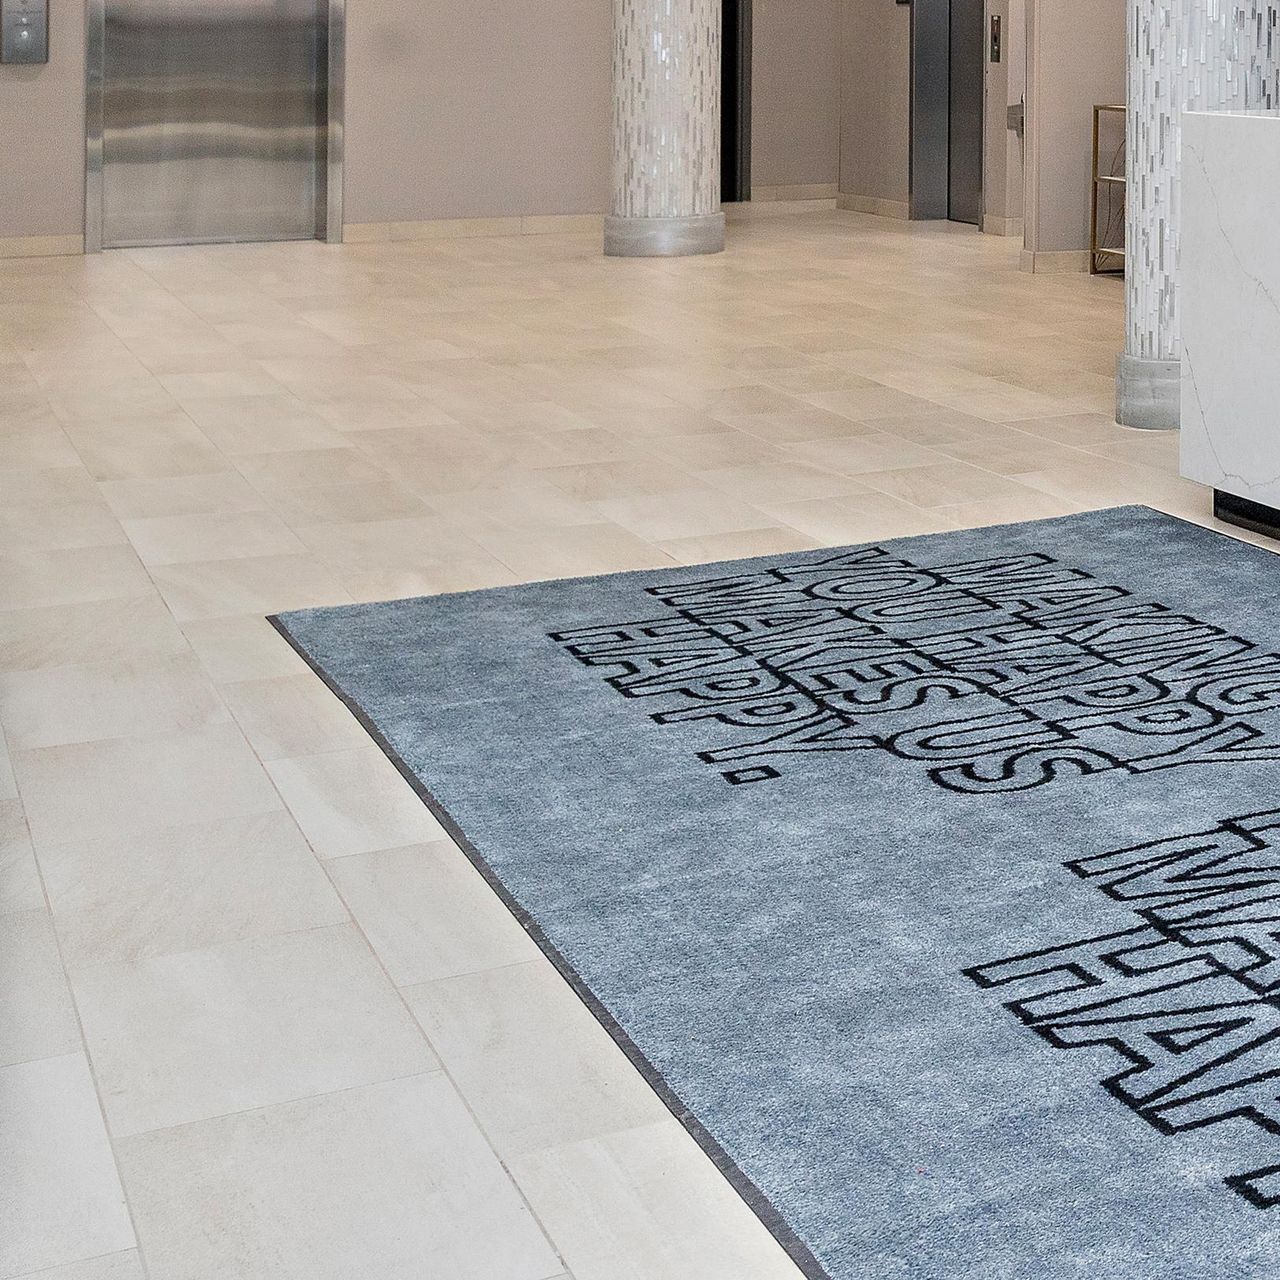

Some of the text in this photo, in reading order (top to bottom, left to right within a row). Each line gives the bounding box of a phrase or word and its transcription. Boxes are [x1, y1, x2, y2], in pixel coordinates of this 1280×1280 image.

[763, 546, 1001, 625] YOU
[548, 616, 893, 785] HAPPY.
[644, 570, 1124, 794] MAKES US
